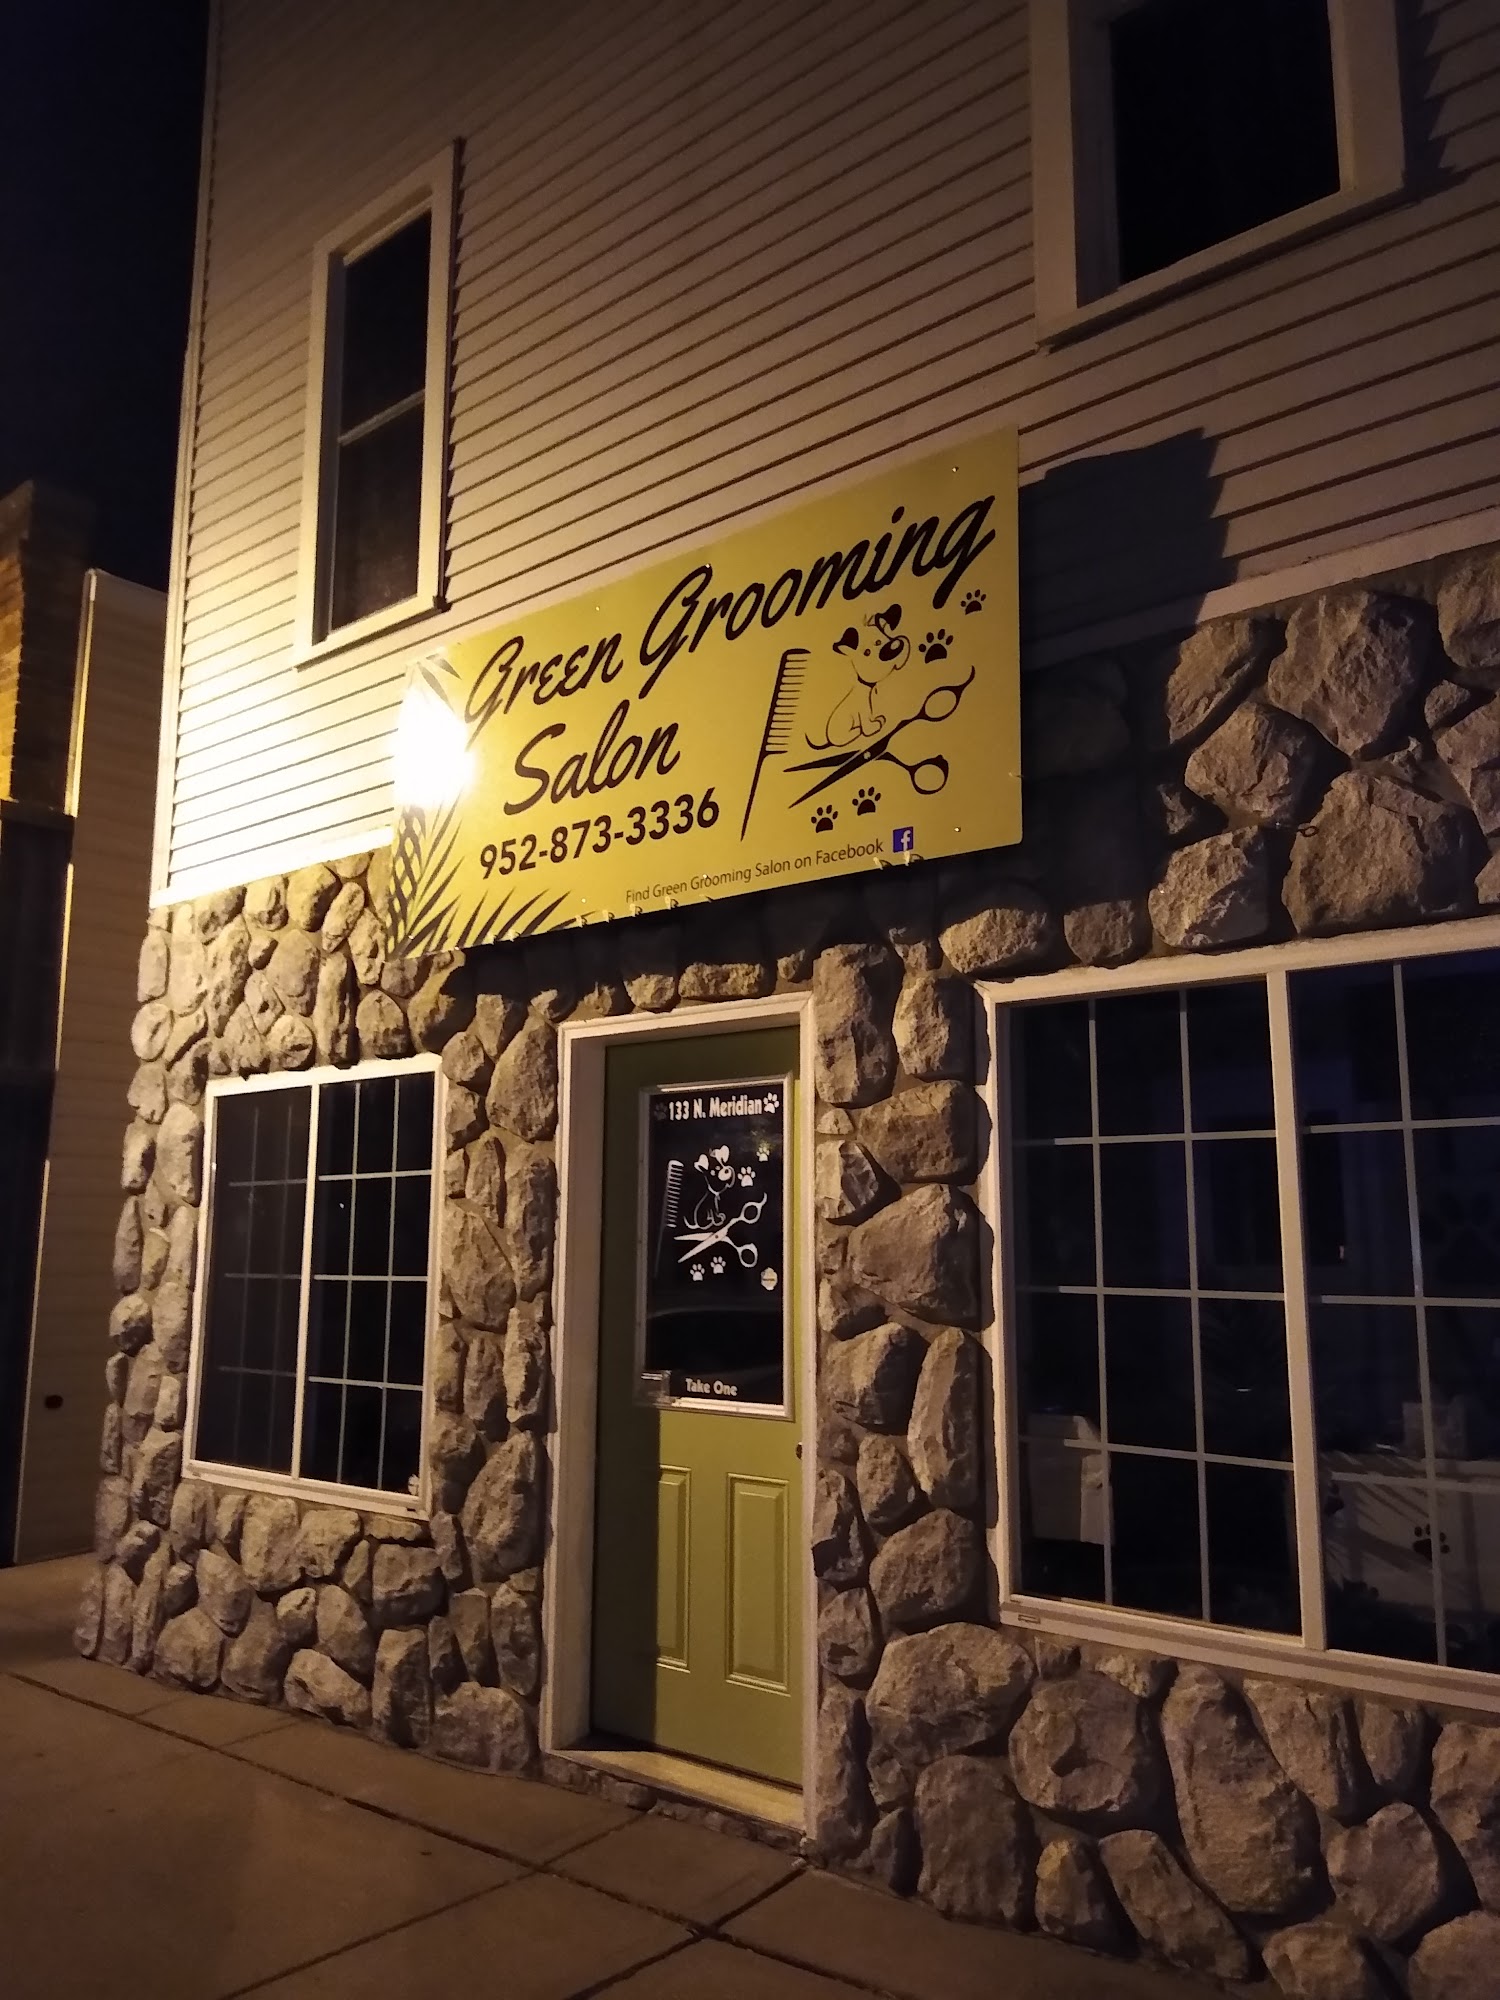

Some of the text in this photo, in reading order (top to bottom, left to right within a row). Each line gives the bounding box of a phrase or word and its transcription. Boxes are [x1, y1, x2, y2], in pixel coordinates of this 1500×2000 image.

[464, 494, 997, 751] Green Grooming
[503, 699, 681, 815] Salon
[479, 785, 720, 880] 952-873-3336
[626, 838, 884, 903] Find Green Grooming Salon on Facebook
[668, 1094, 763, 1121] 133 N. Meridian
[685, 1377, 738, 1397] Take One
